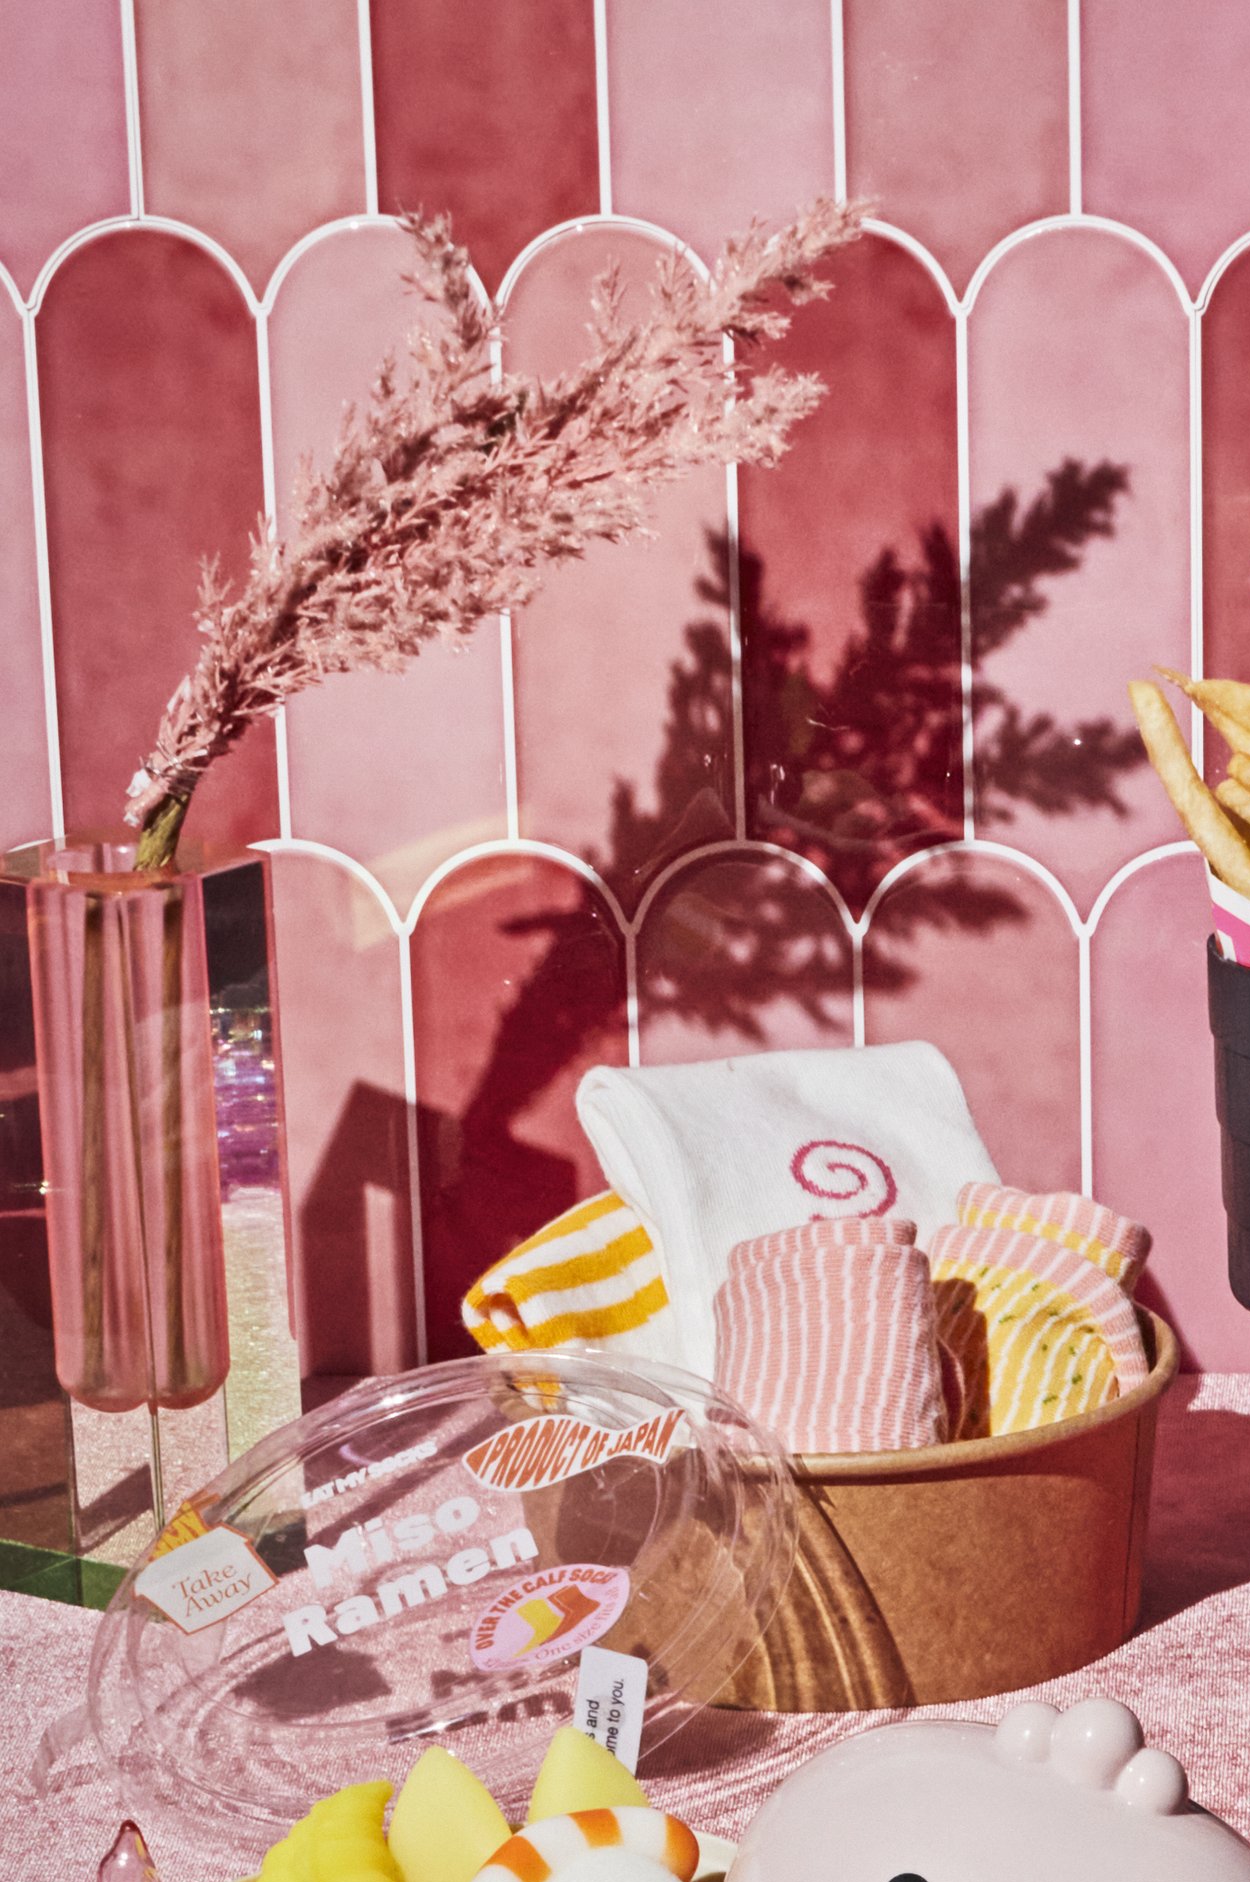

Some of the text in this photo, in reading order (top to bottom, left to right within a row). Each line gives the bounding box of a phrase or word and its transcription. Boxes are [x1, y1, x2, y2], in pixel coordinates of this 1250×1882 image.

[479, 1408, 685, 1489] PRODUCT OF JAPAN
[336, 1466, 369, 1494] MY
[304, 1496, 479, 1590] Miso
[172, 1564, 238, 1599] Take
[186, 1573, 251, 1618] Away
[282, 1527, 539, 1657] Ramen
[475, 1611, 501, 1650] OVER
[494, 1590, 523, 1614] THE
[522, 1569, 567, 1594] CALF
[611, 1678, 626, 1706] you.
[586, 1699, 600, 1729] and
[607, 1707, 621, 1724] to
